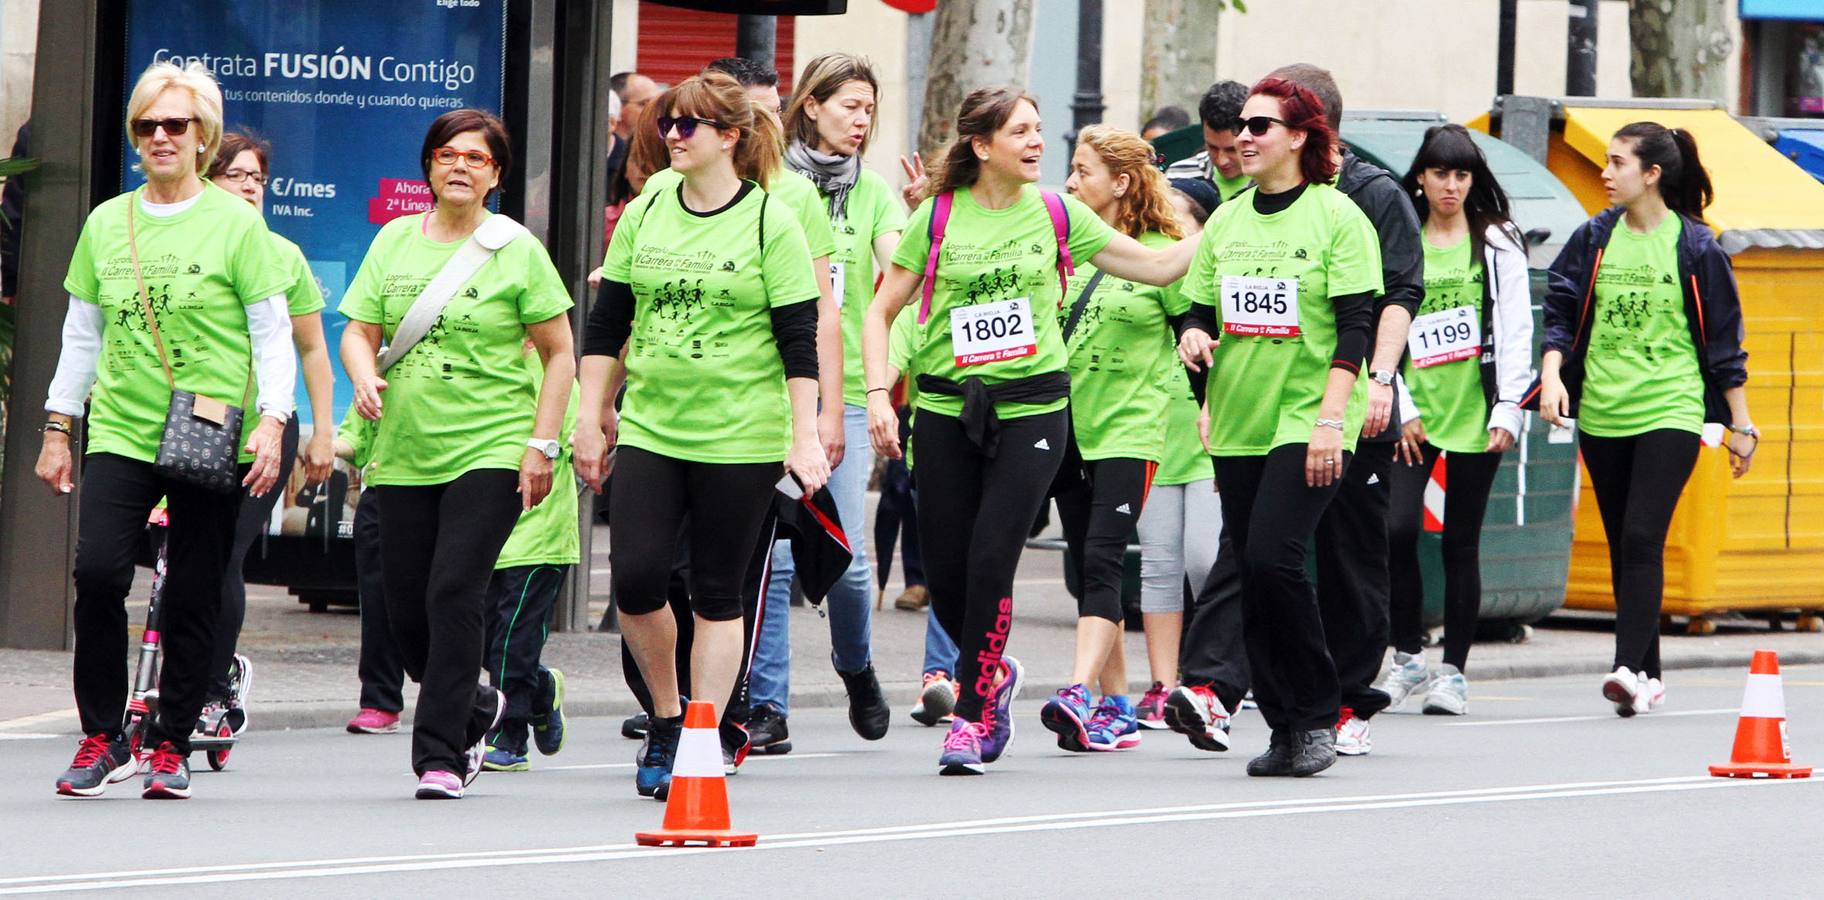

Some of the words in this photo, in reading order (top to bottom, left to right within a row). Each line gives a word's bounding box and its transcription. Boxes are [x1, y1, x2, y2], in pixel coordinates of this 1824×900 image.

[264, 46, 371, 80] FUSIÓN
[379, 57, 474, 90] Contigo
[225, 89, 243, 101] tus
[245, 90, 312, 103] contenidos
[315, 91, 354, 105] donde
[357, 95, 365, 108] y
[368, 93, 415, 106] cuando
[418, 95, 464, 109] quieras
[271, 177, 336, 198] €/mes
[395, 182, 430, 194] Ahora
[272, 205, 291, 216] IVA
[294, 205, 314, 217] Inc.
[401, 198, 431, 211] Línea
[680, 258, 714, 270] Familia
[1231, 291, 1287, 314] 1845
[962, 314, 1023, 342] 1802
[1419, 322, 1470, 349] 1199
[975, 598, 1012, 696] adidas
